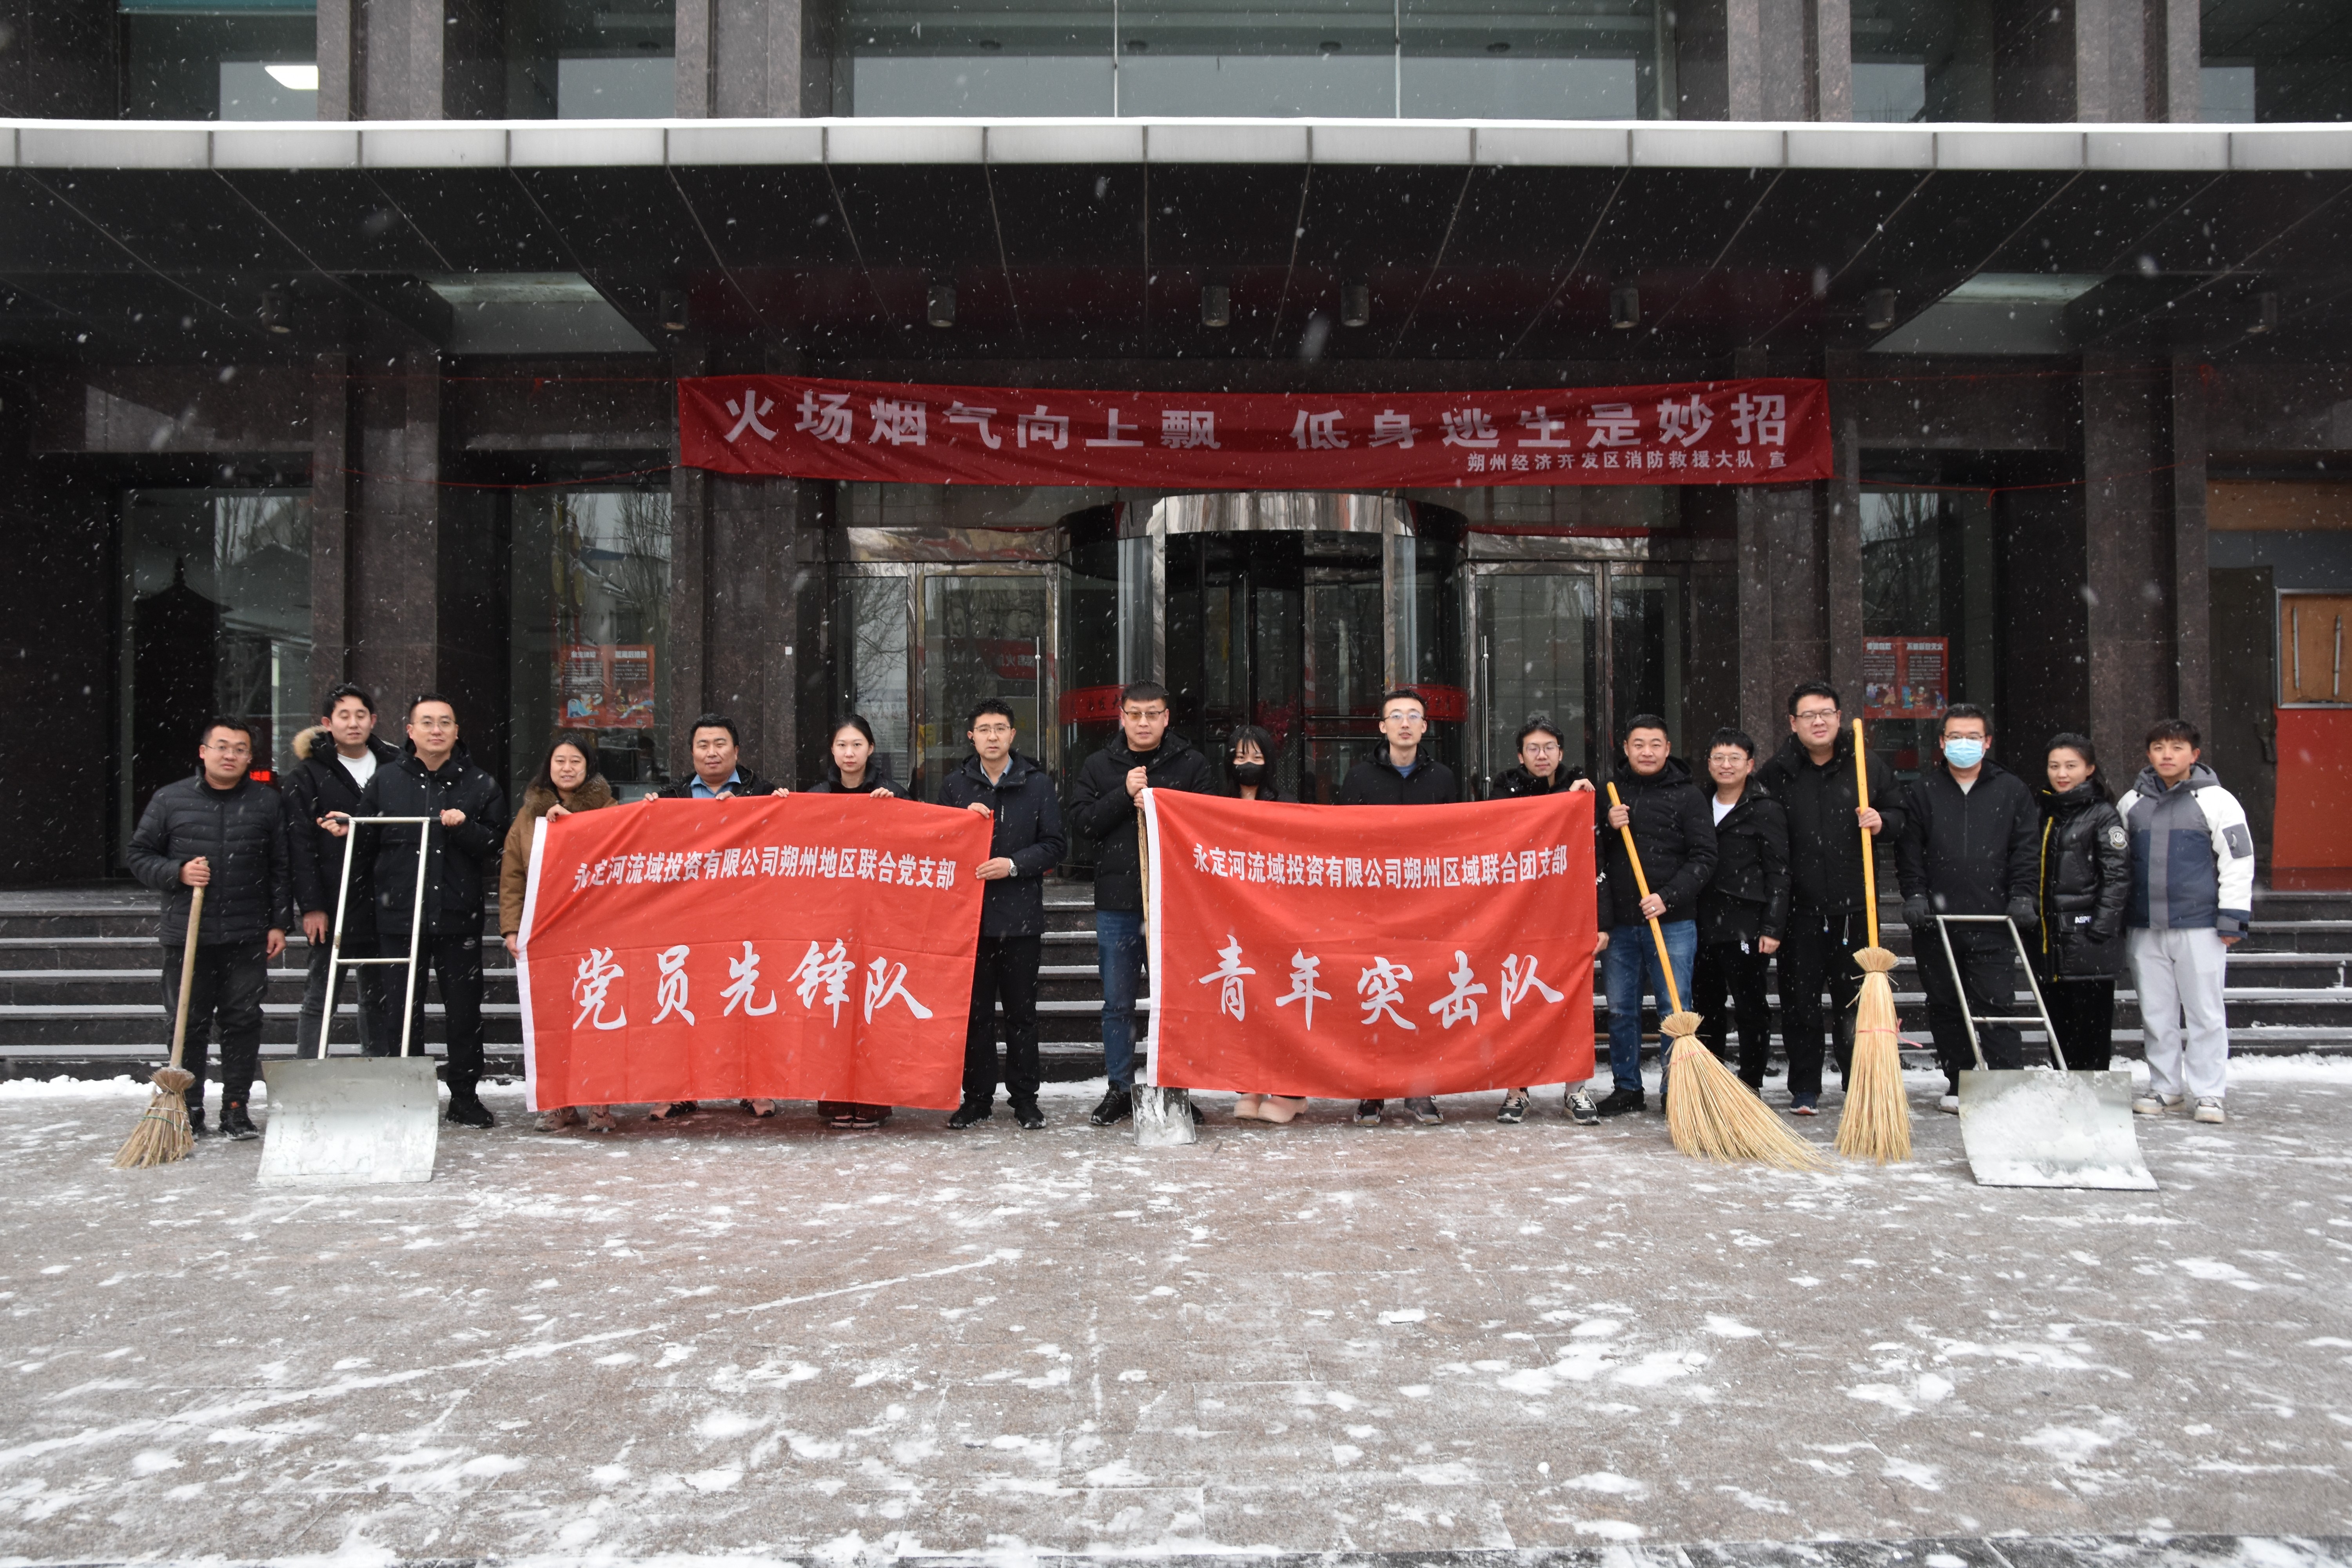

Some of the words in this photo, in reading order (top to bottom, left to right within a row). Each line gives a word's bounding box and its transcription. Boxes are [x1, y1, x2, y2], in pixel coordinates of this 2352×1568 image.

[724, 389, 1221, 450] 火场烟气向上飘
[1289, 392, 1787, 449] 低身逃生是妙招
[1467, 450, 1755, 472] 朔州经济开发区消防救援大队
[1768, 451, 1787, 469] 宣
[571, 844, 956, 893] 永定河流域投资有限公司朔州地区联合党支部
[1192, 842, 1568, 889] 永定河流域投资有限公司朔州区域联合团支部
[572, 937, 933, 1030] 党员先锋队
[1199, 934, 1565, 1031] 青年突击队
